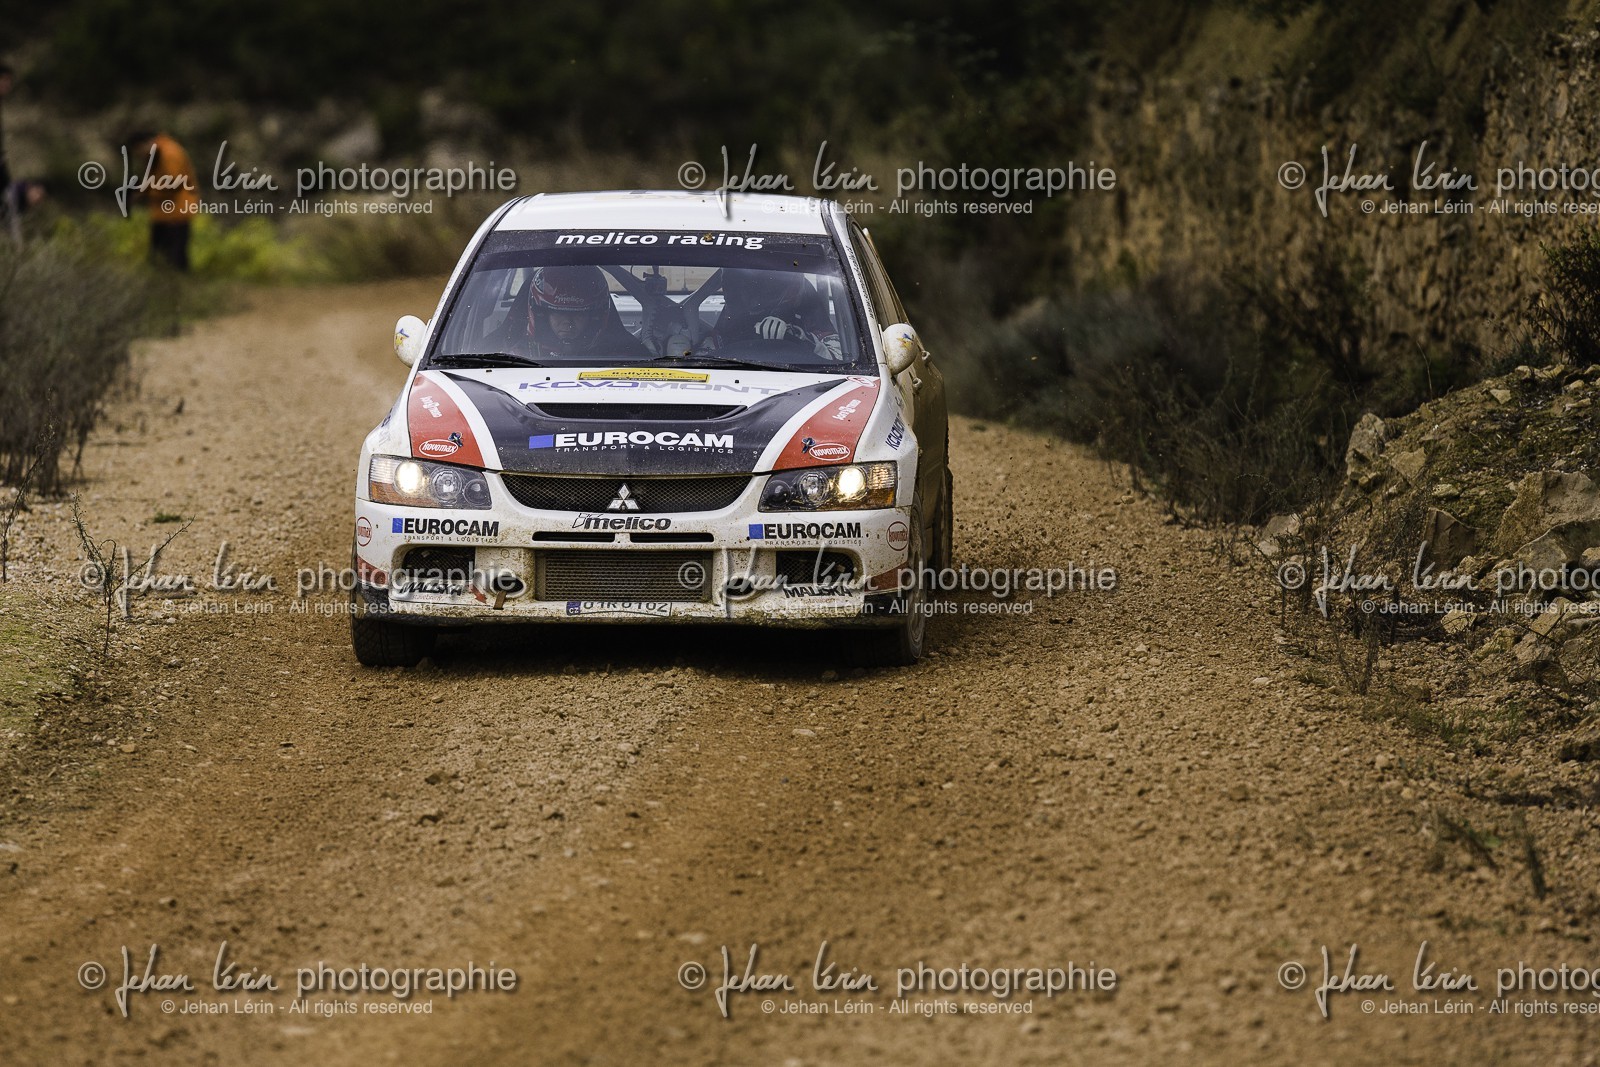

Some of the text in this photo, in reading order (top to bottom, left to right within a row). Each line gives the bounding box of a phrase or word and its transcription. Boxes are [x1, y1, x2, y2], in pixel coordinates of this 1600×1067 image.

[555, 232, 765, 250] melico racing
[518, 380, 781, 395] KOVOMONT
[555, 430, 735, 448] EUROCAM
[555, 444, 636, 453] TRANSPORT
[659, 446, 735, 454] LOGISTICS
[403, 517, 500, 537] EUROCAM
[584, 516, 672, 531] melico
[763, 522, 862, 540] EUROCAM
[456, 535, 500, 544] LOGISTICS
